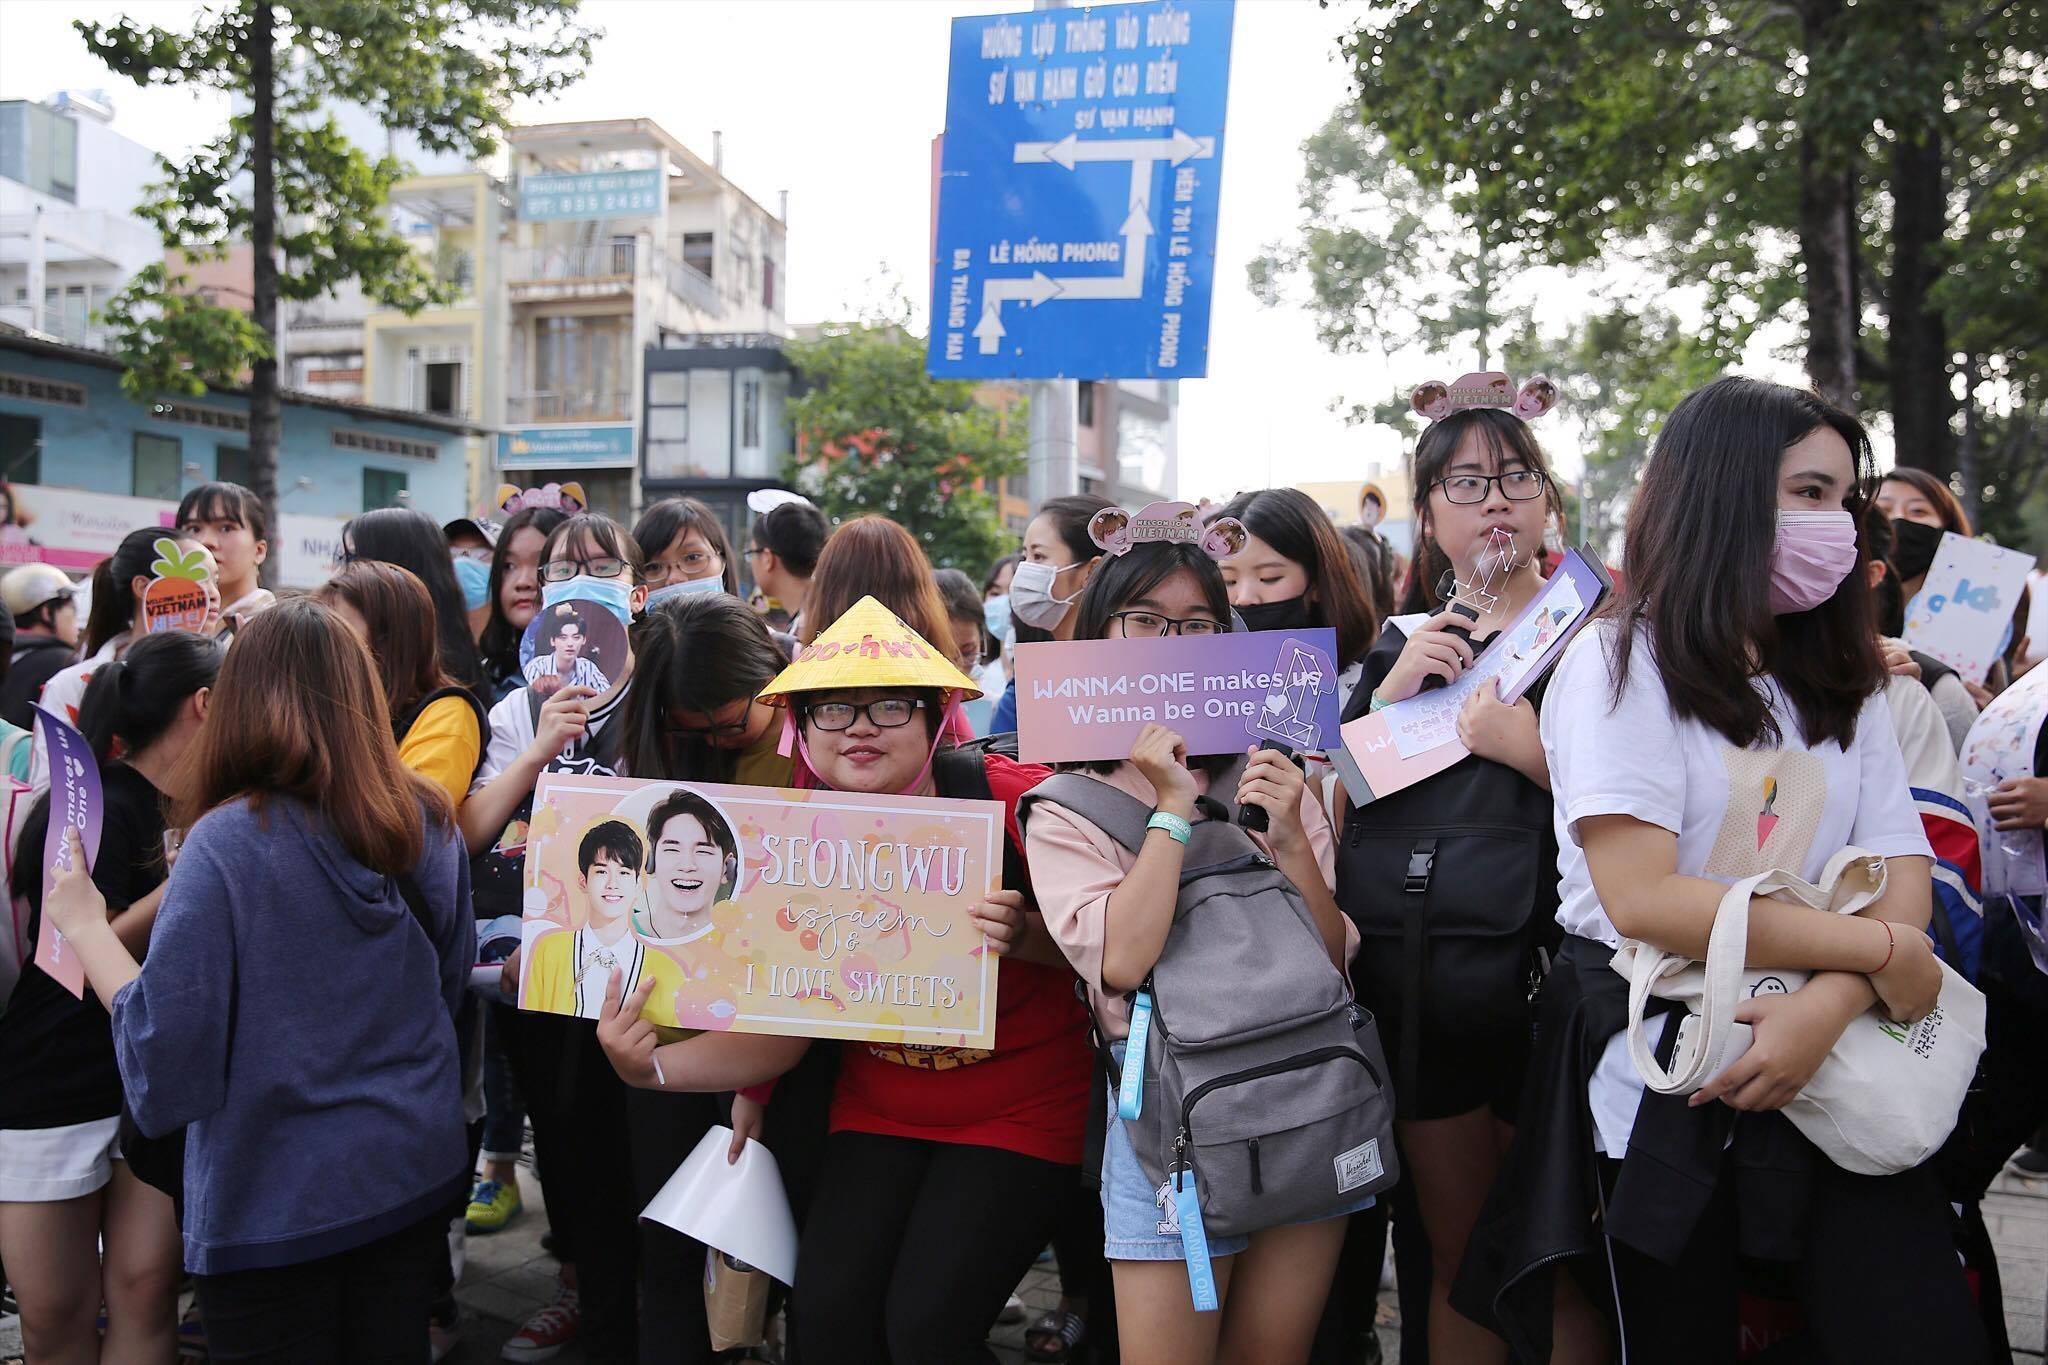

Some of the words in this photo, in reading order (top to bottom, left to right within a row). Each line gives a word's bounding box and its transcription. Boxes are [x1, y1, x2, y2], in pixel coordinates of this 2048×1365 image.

[1113, 63, 1138, 97] CAO
[1100, 107, 1129, 133] VẠN
[1133, 106, 1175, 132] HẠNH
[952, 249, 971, 271] BA
[989, 239, 1010, 264] LÊ
[1062, 242, 1120, 262] PHONG
[1169, 236, 1192, 257] LÊ
[948, 274, 971, 328] THÁNG
[945, 332, 964, 361] HAI
[1158, 313, 1181, 368] PHONG
[1132, 527, 1199, 540] VIETNAM
[147, 597, 207, 616] VIETNAM
[1203, 670, 1284, 692] makes
[1291, 671, 1322, 688] us
[1068, 703, 1156, 725] Wanna
[1165, 700, 1195, 721] be
[1204, 698, 1256, 718] One
[55, 727, 70, 749] us
[66, 755, 77, 823] makes
[77, 786, 88, 830] One
[760, 834, 969, 896] SEONGWU
[846, 931, 860, 951] &
[745, 963, 755, 995] I
[768, 964, 835, 1000] LOVE
[849, 970, 957, 1009] SWEETS
[1184, 1211, 1207, 1274] WANNA
[1195, 1277, 1213, 1311] ONE
